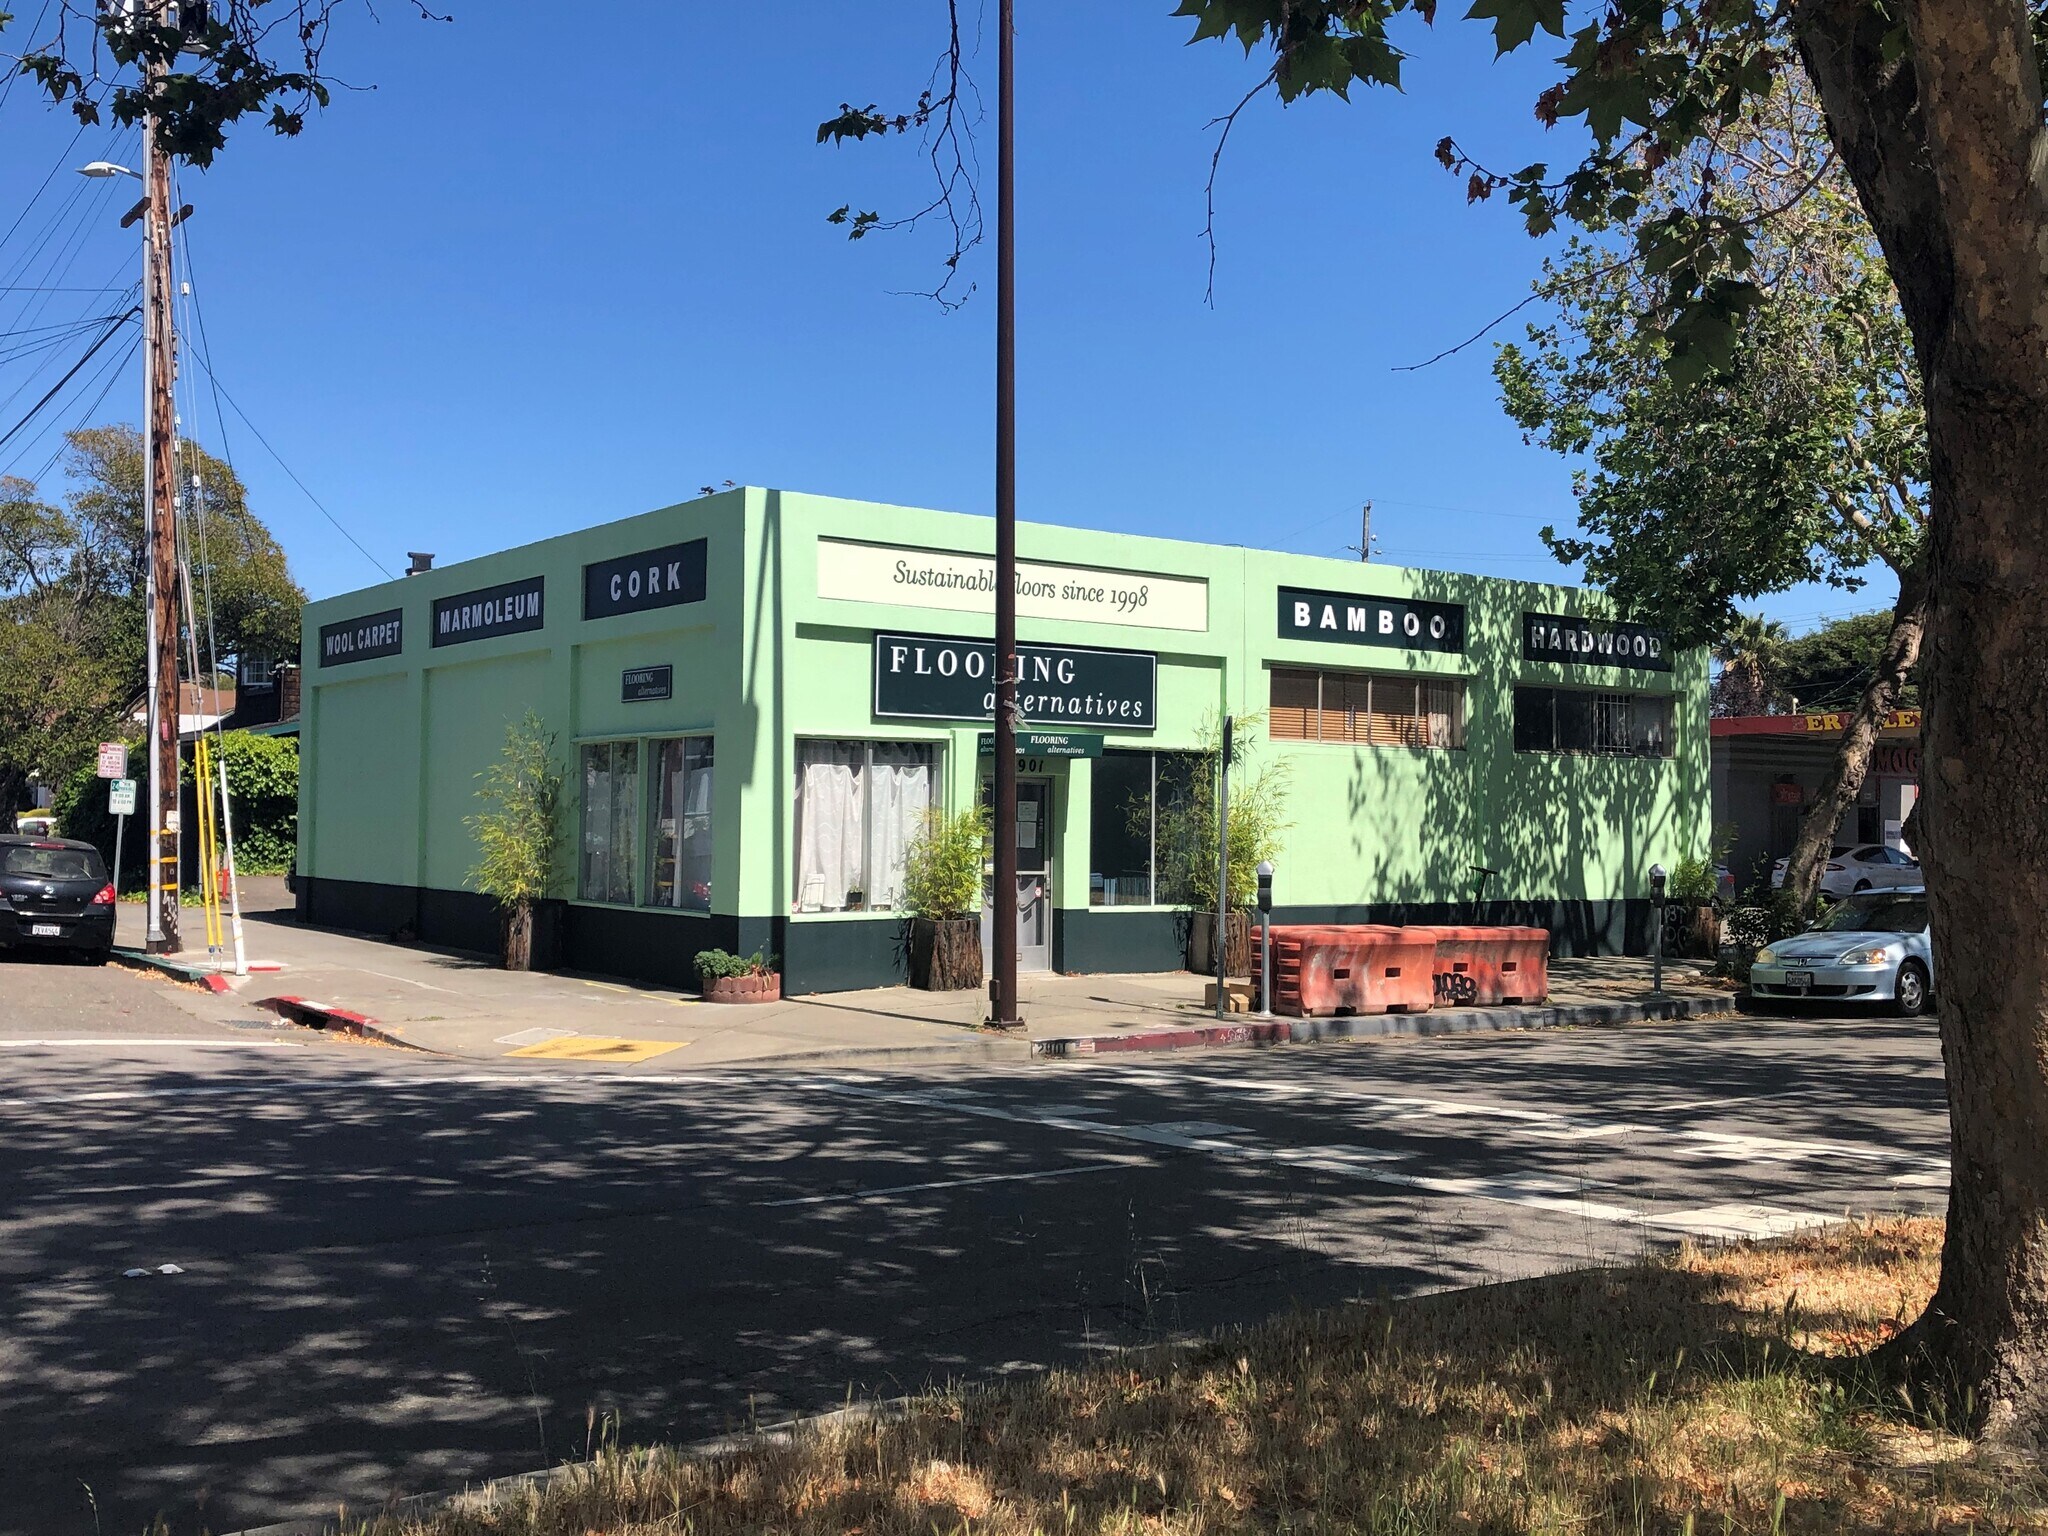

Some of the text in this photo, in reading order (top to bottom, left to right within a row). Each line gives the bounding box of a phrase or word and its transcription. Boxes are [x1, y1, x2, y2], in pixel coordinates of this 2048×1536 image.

[610, 562, 681, 601] CORK
[893, 560, 1150, 614] Sustainabl loors since 1998
[440, 592, 539, 634] MARMOLEUM
[1294, 601, 1446, 639] BAMBOO
[325, 620, 400, 657] WOOL CARPET
[1530, 625, 1661, 659] HARDWOOD
[624, 672, 654, 685] FLOORING
[890, 646, 1076, 684] FLOOING
[982, 690, 1143, 719] aternatives
[1030, 735, 1069, 745] FLOORING
[1047, 745, 1085, 755] alternatives
[1018, 759, 1044, 773] 901
